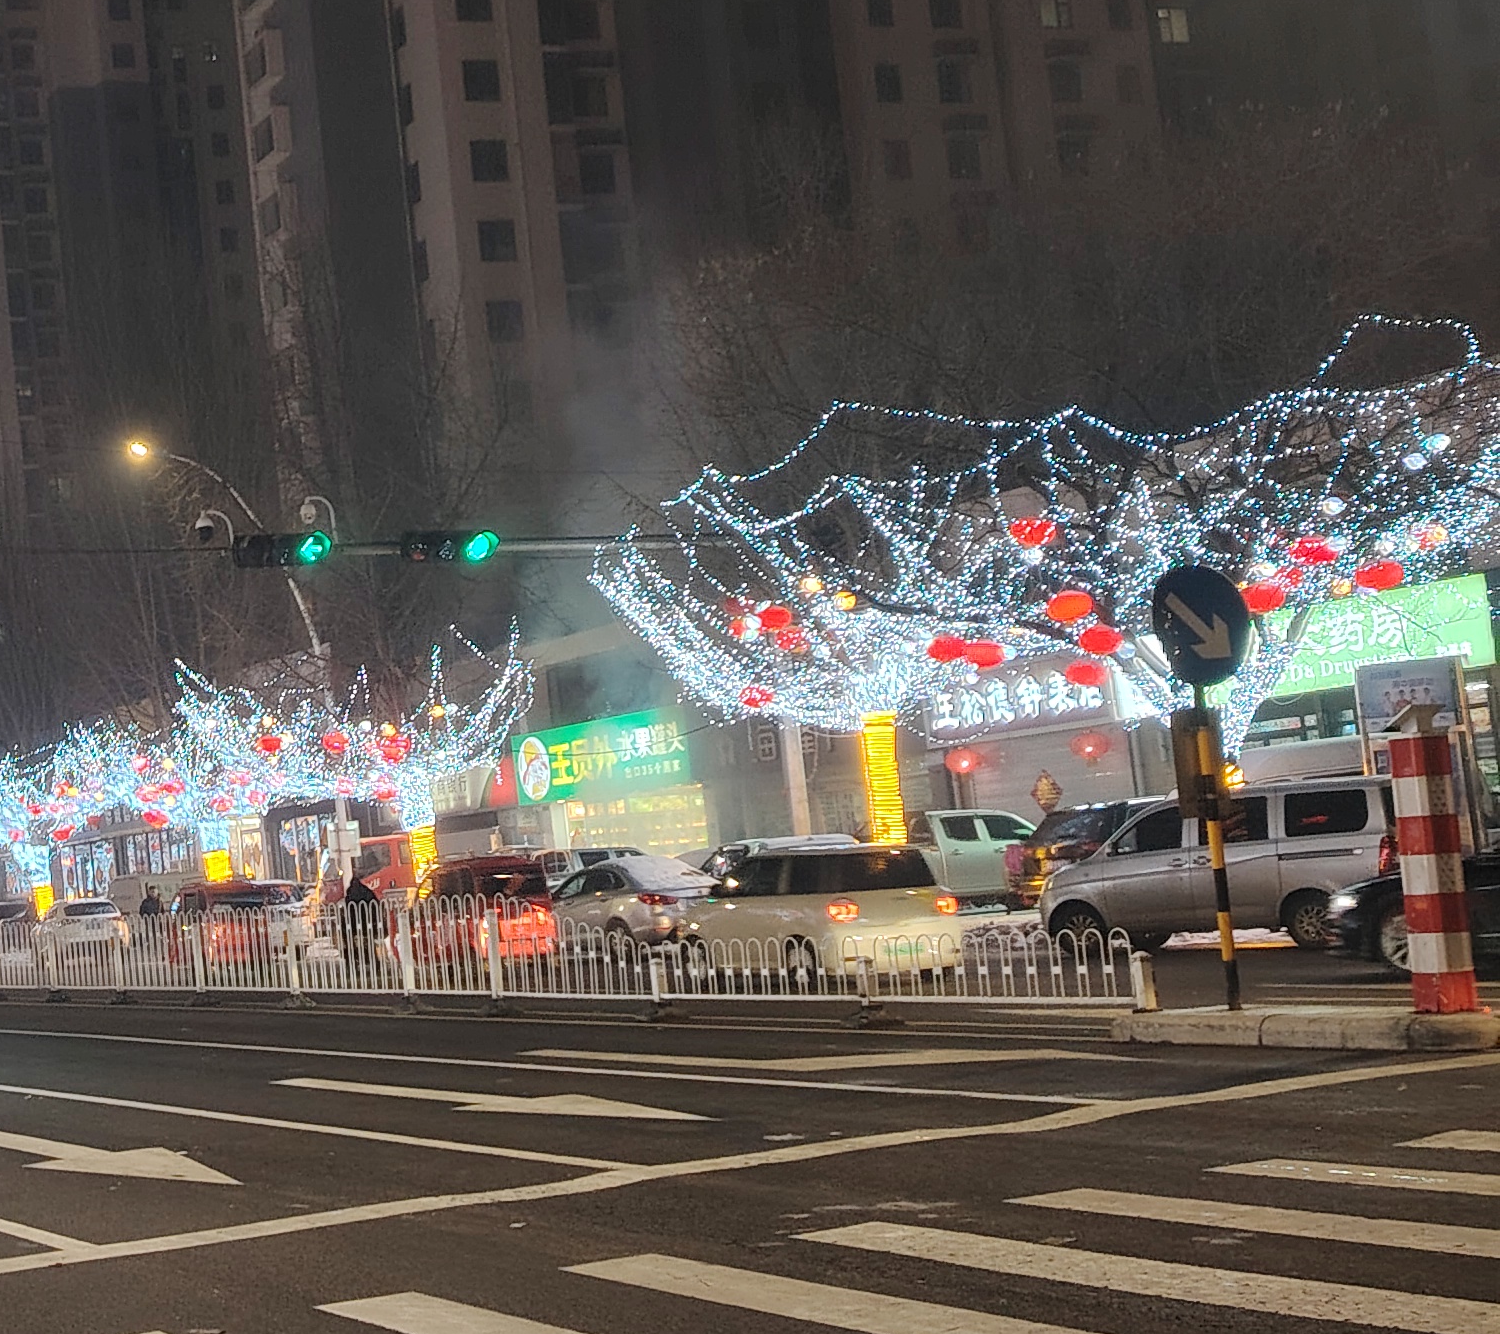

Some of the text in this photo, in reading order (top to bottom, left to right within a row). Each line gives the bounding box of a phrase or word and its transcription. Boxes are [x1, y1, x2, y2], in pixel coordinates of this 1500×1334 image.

[548, 721, 687, 786] 王员外 水果罐头
